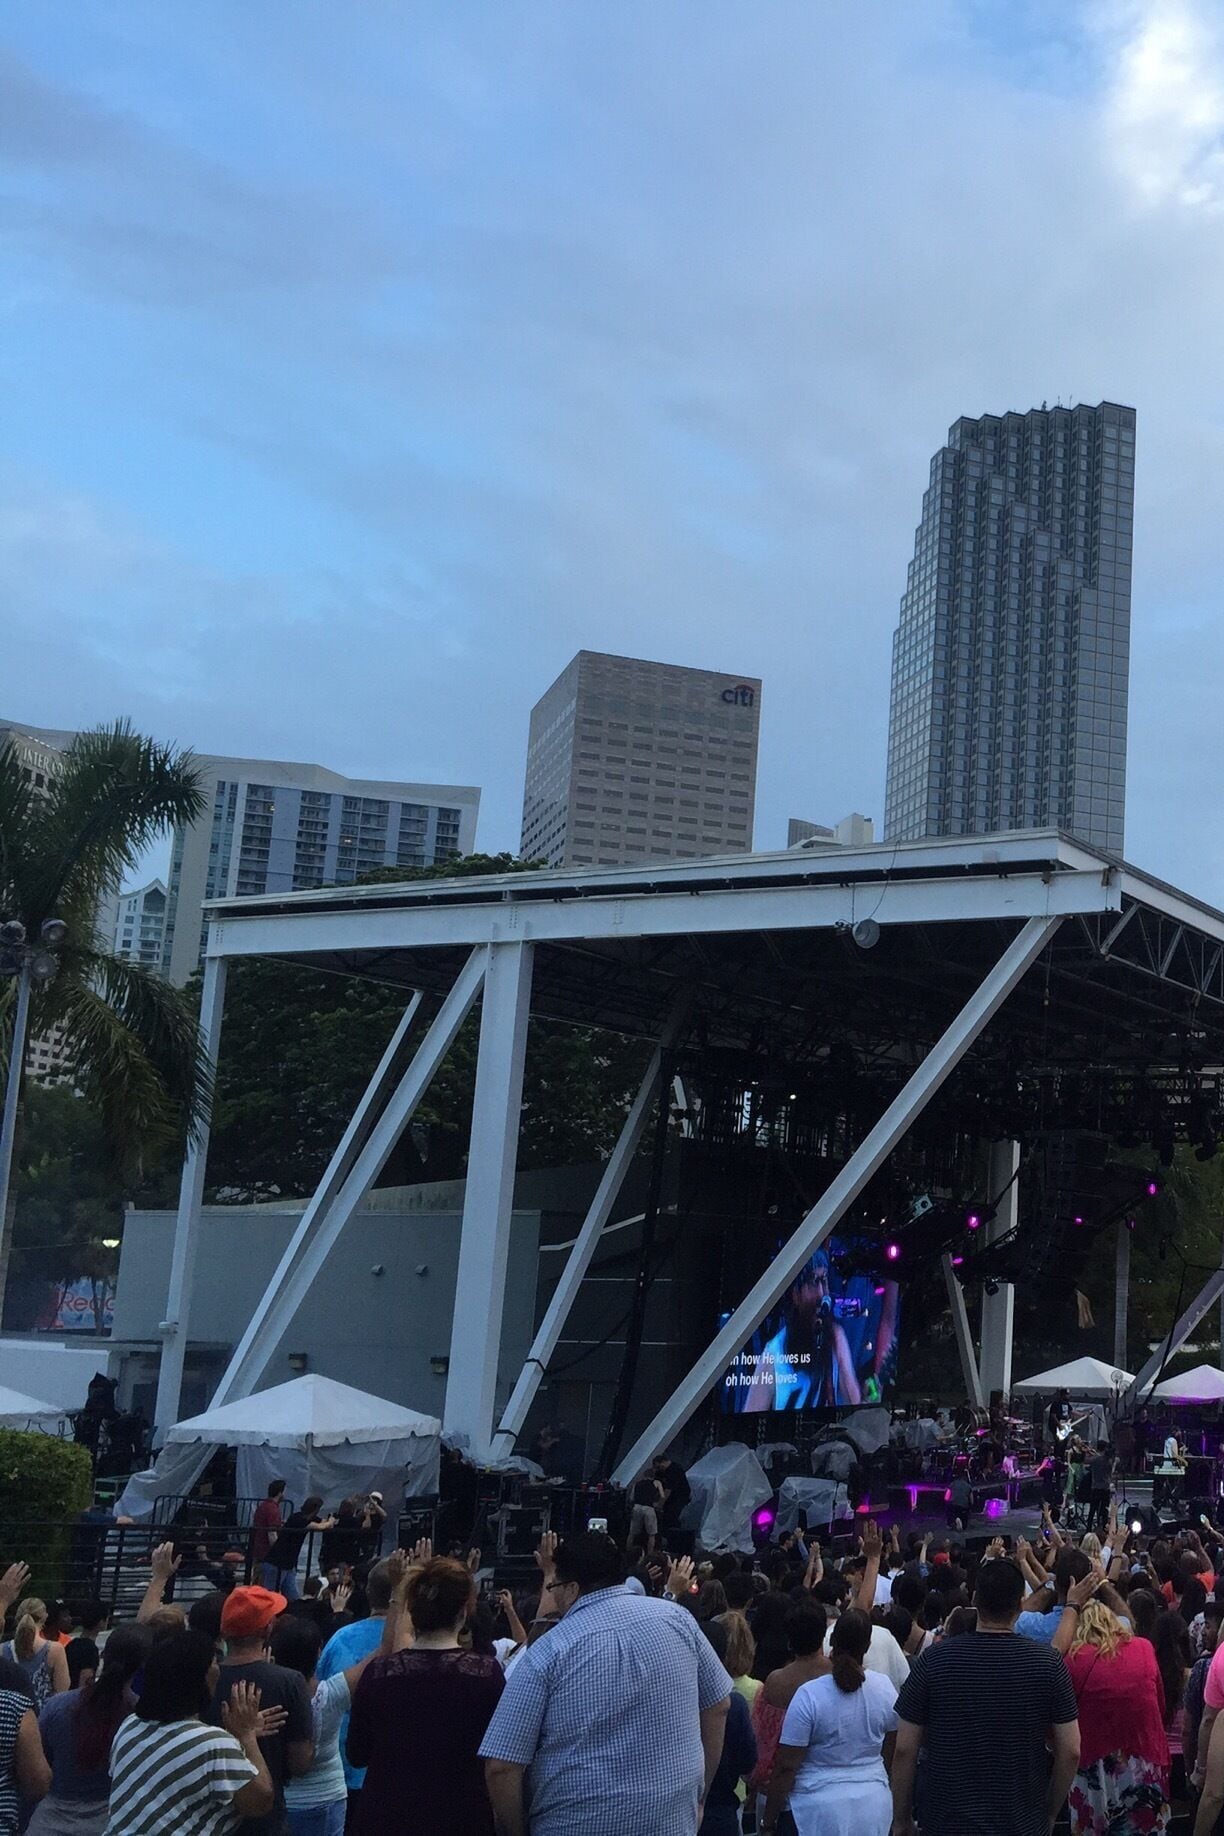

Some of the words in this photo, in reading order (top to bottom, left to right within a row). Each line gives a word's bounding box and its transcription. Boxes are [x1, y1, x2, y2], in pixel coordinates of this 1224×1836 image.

[721, 684, 755, 707] citi
[741, 1352, 760, 1365] how
[762, 1351, 774, 1364] He
[776, 1351, 798, 1364] loves
[800, 1353, 811, 1363] us
[725, 1373, 738, 1386] oh
[740, 1372, 759, 1386] how
[761, 1371, 773, 1384] He
[776, 1371, 798, 1384] loves
